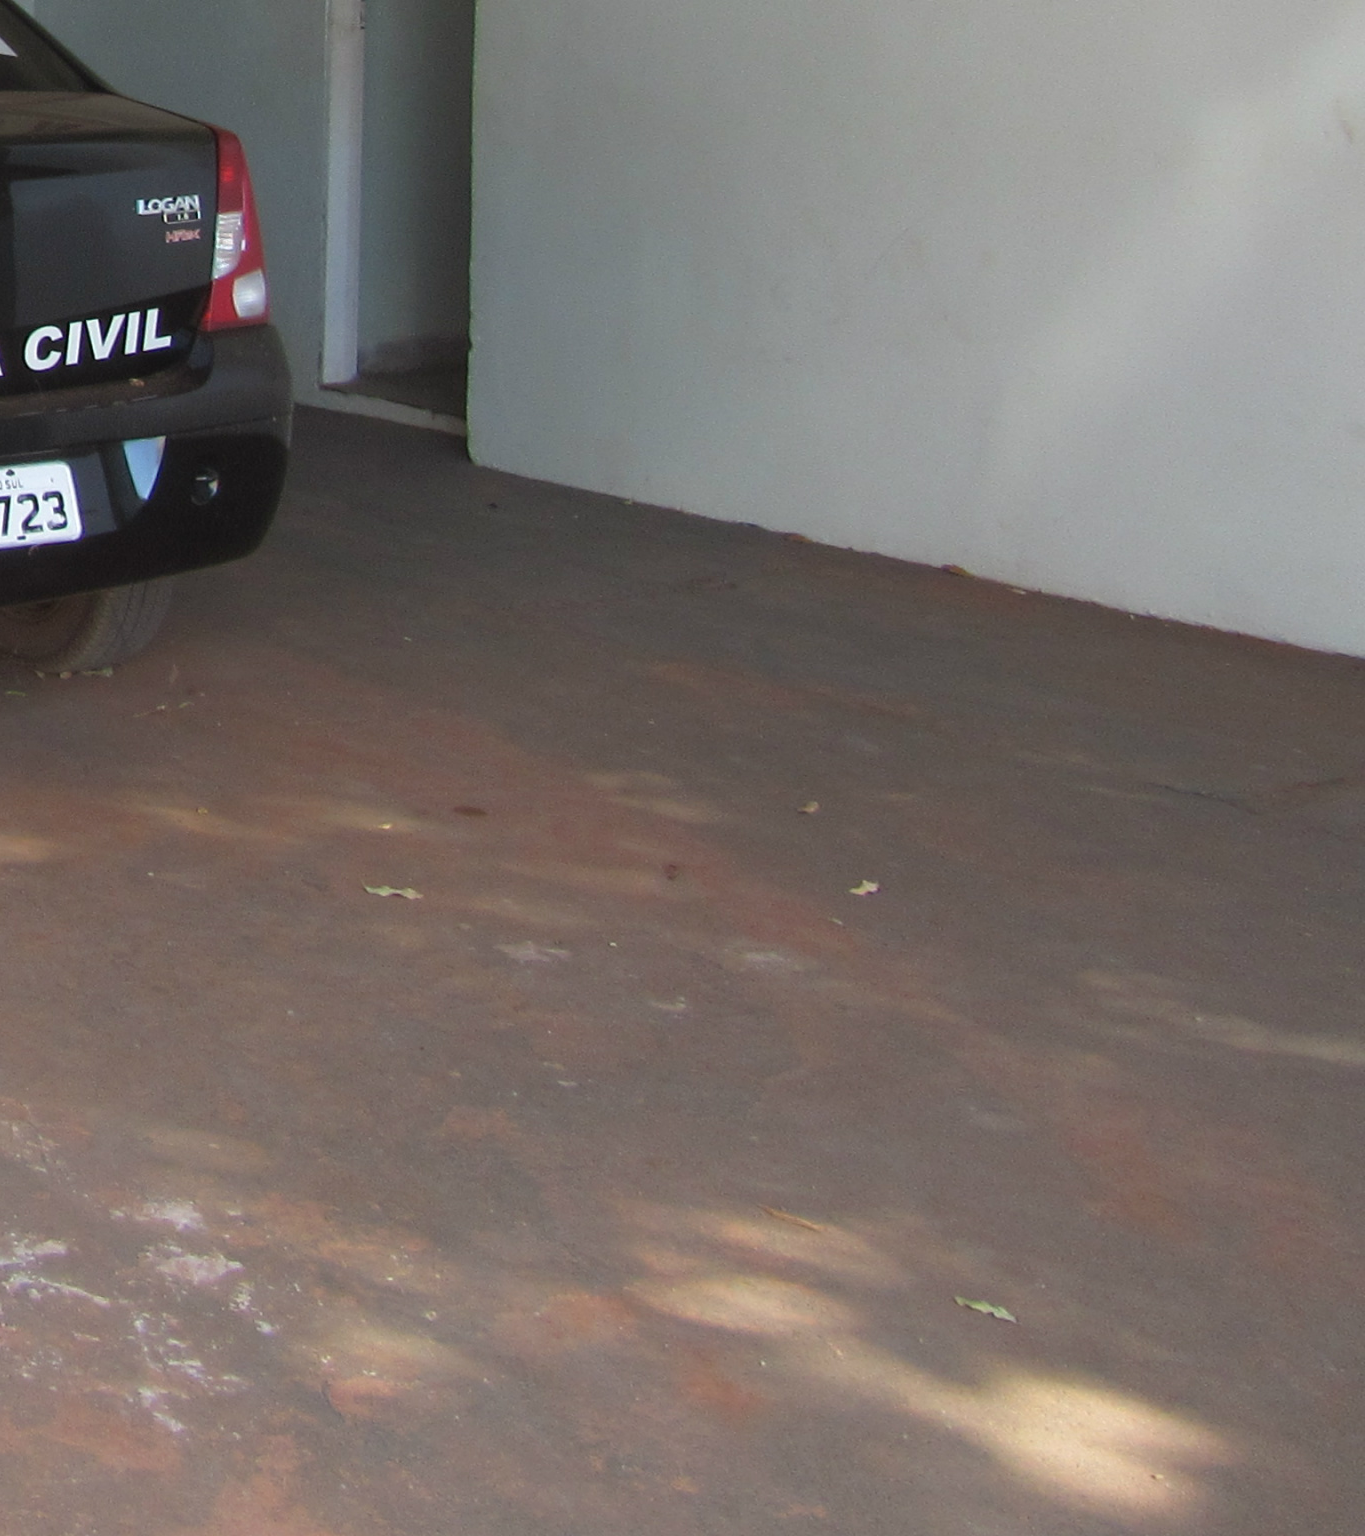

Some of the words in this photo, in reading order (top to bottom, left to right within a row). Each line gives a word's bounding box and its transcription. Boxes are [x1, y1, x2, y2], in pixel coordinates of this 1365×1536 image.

[135, 195, 201, 215] LOGAN
[23, 307, 172, 373] CIVIL
[5, 478, 24, 489] SUL
